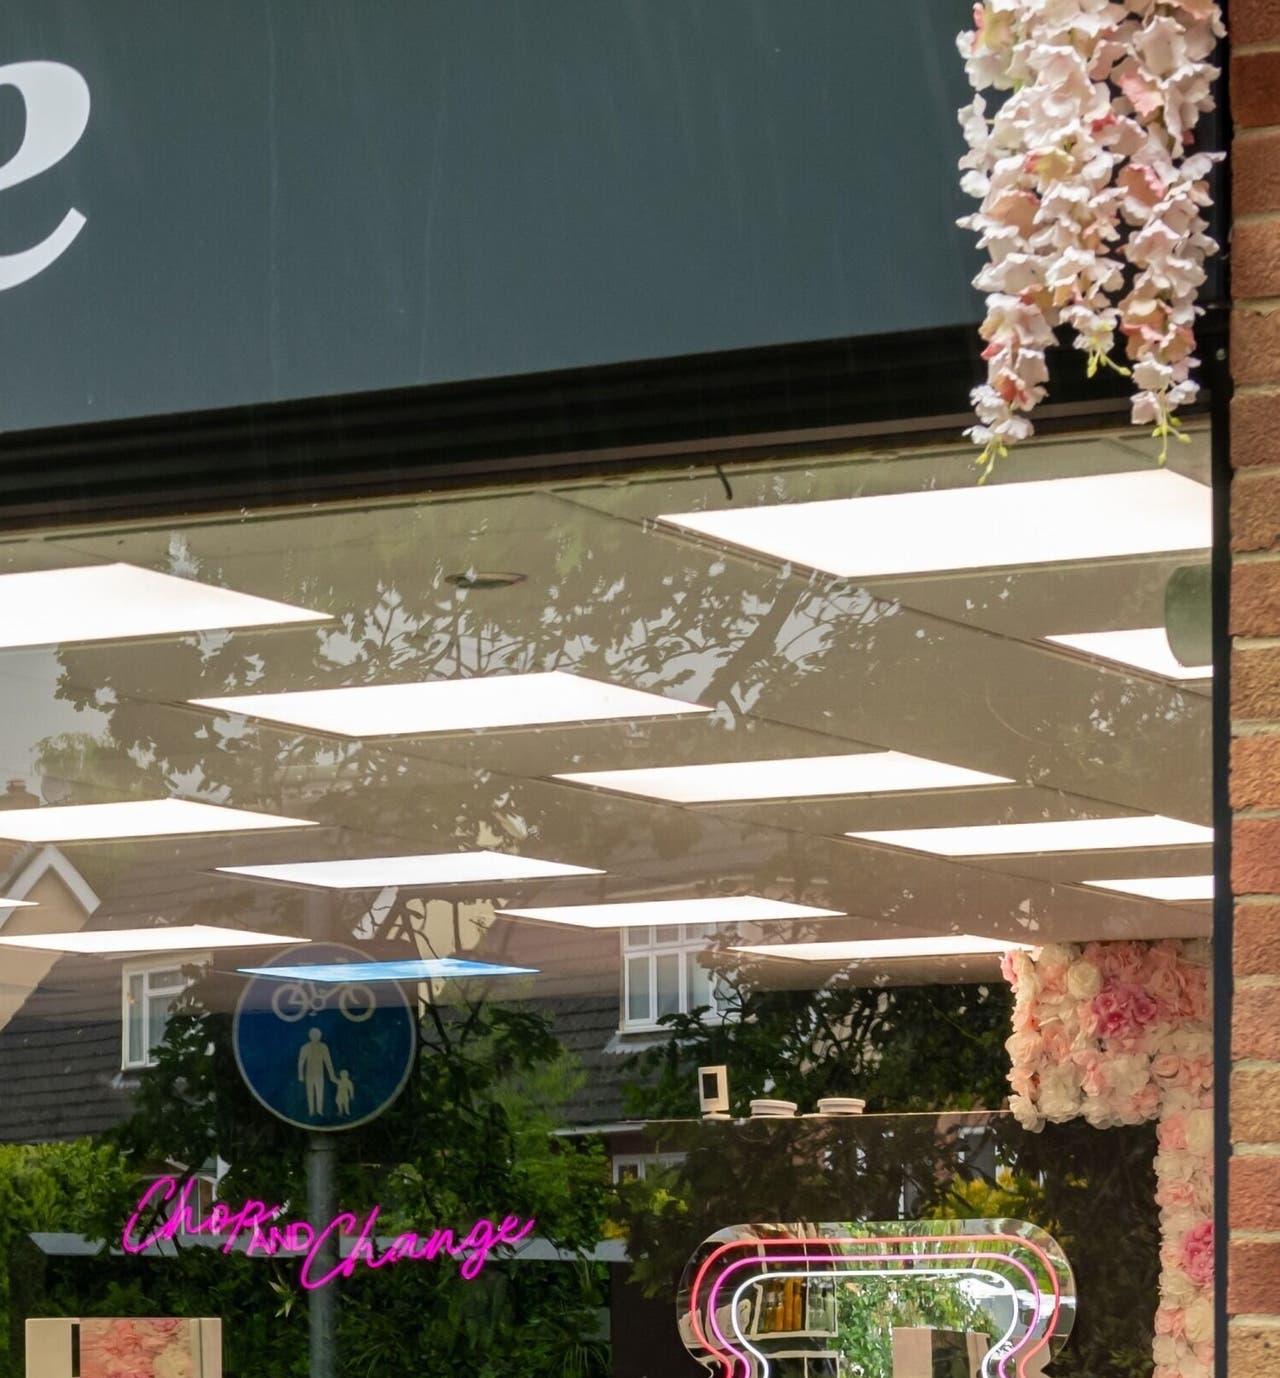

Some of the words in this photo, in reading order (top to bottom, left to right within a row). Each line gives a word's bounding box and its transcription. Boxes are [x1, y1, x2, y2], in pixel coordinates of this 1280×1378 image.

[122, 1176, 282, 1255] Chop
[246, 1222, 315, 1256] AND
[300, 1205, 536, 1290] Change
